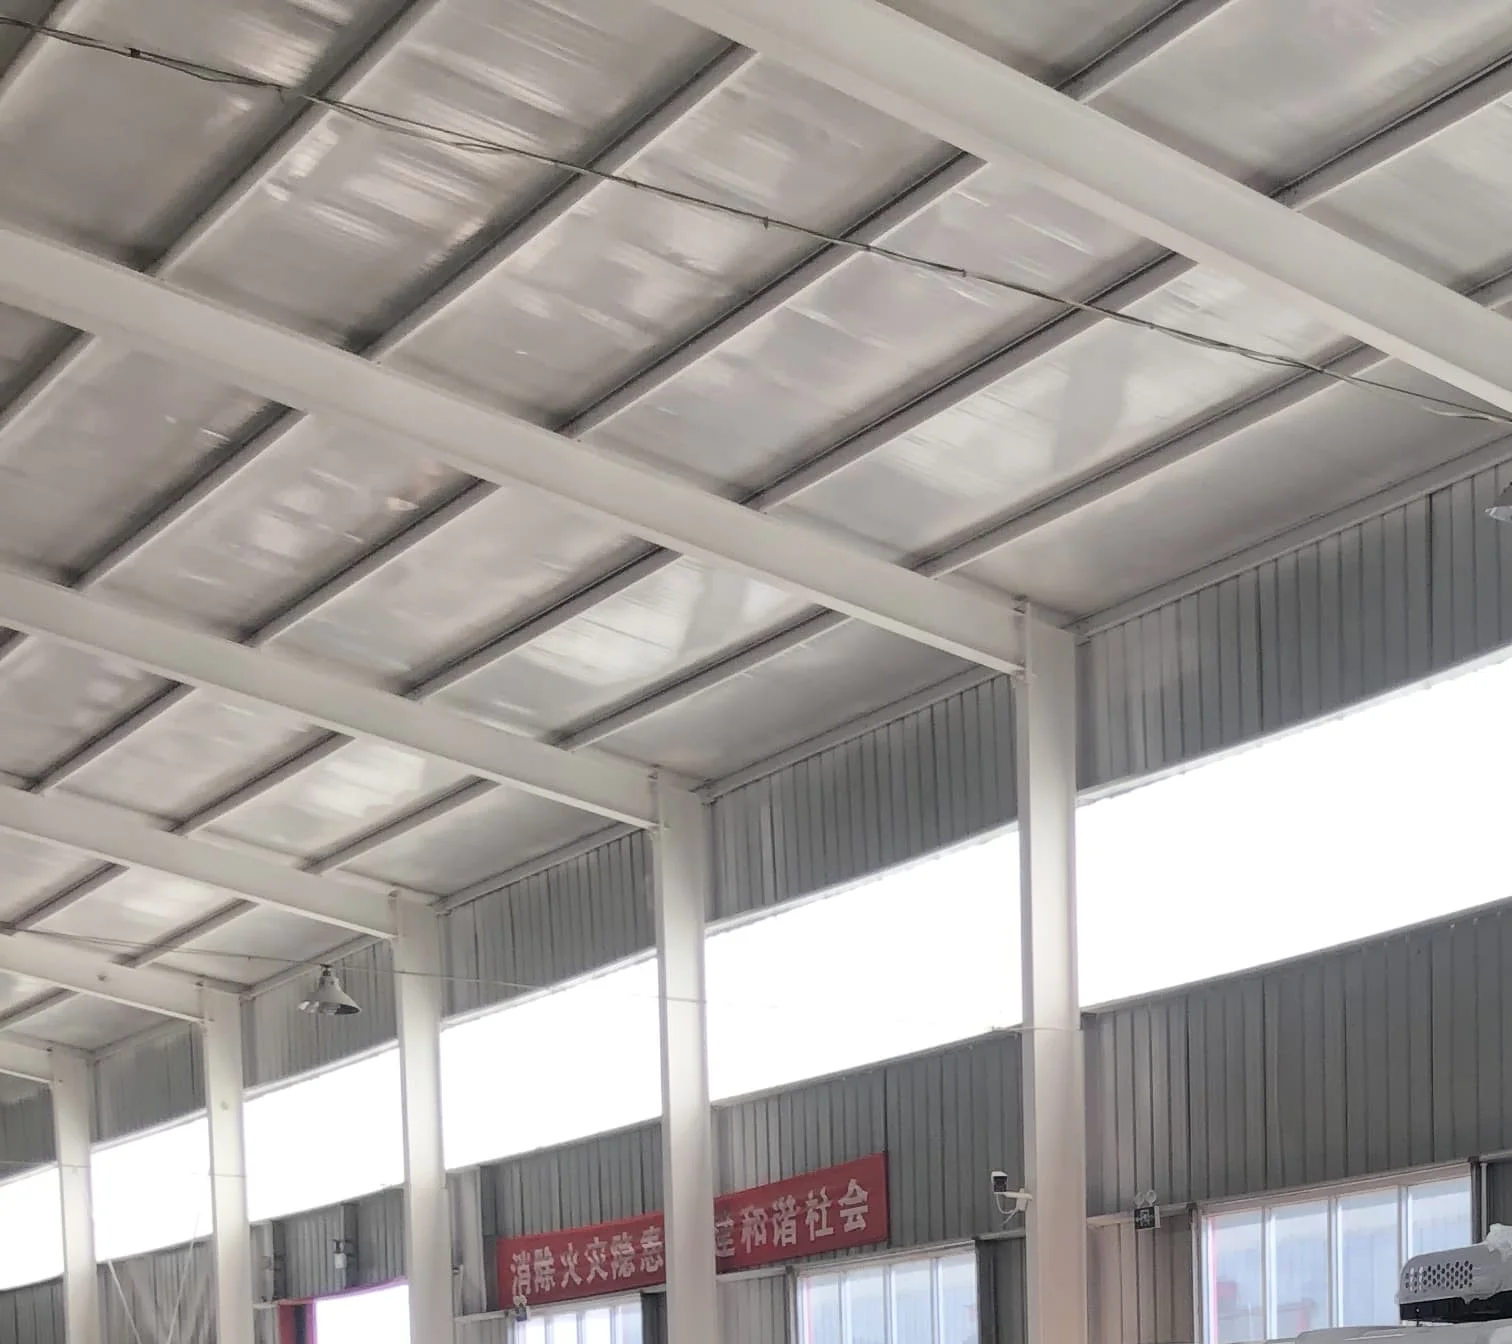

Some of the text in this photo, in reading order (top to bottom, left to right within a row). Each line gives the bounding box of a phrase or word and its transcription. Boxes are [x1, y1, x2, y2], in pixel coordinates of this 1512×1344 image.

[510, 1225, 664, 1297] 消除火灾隐患
